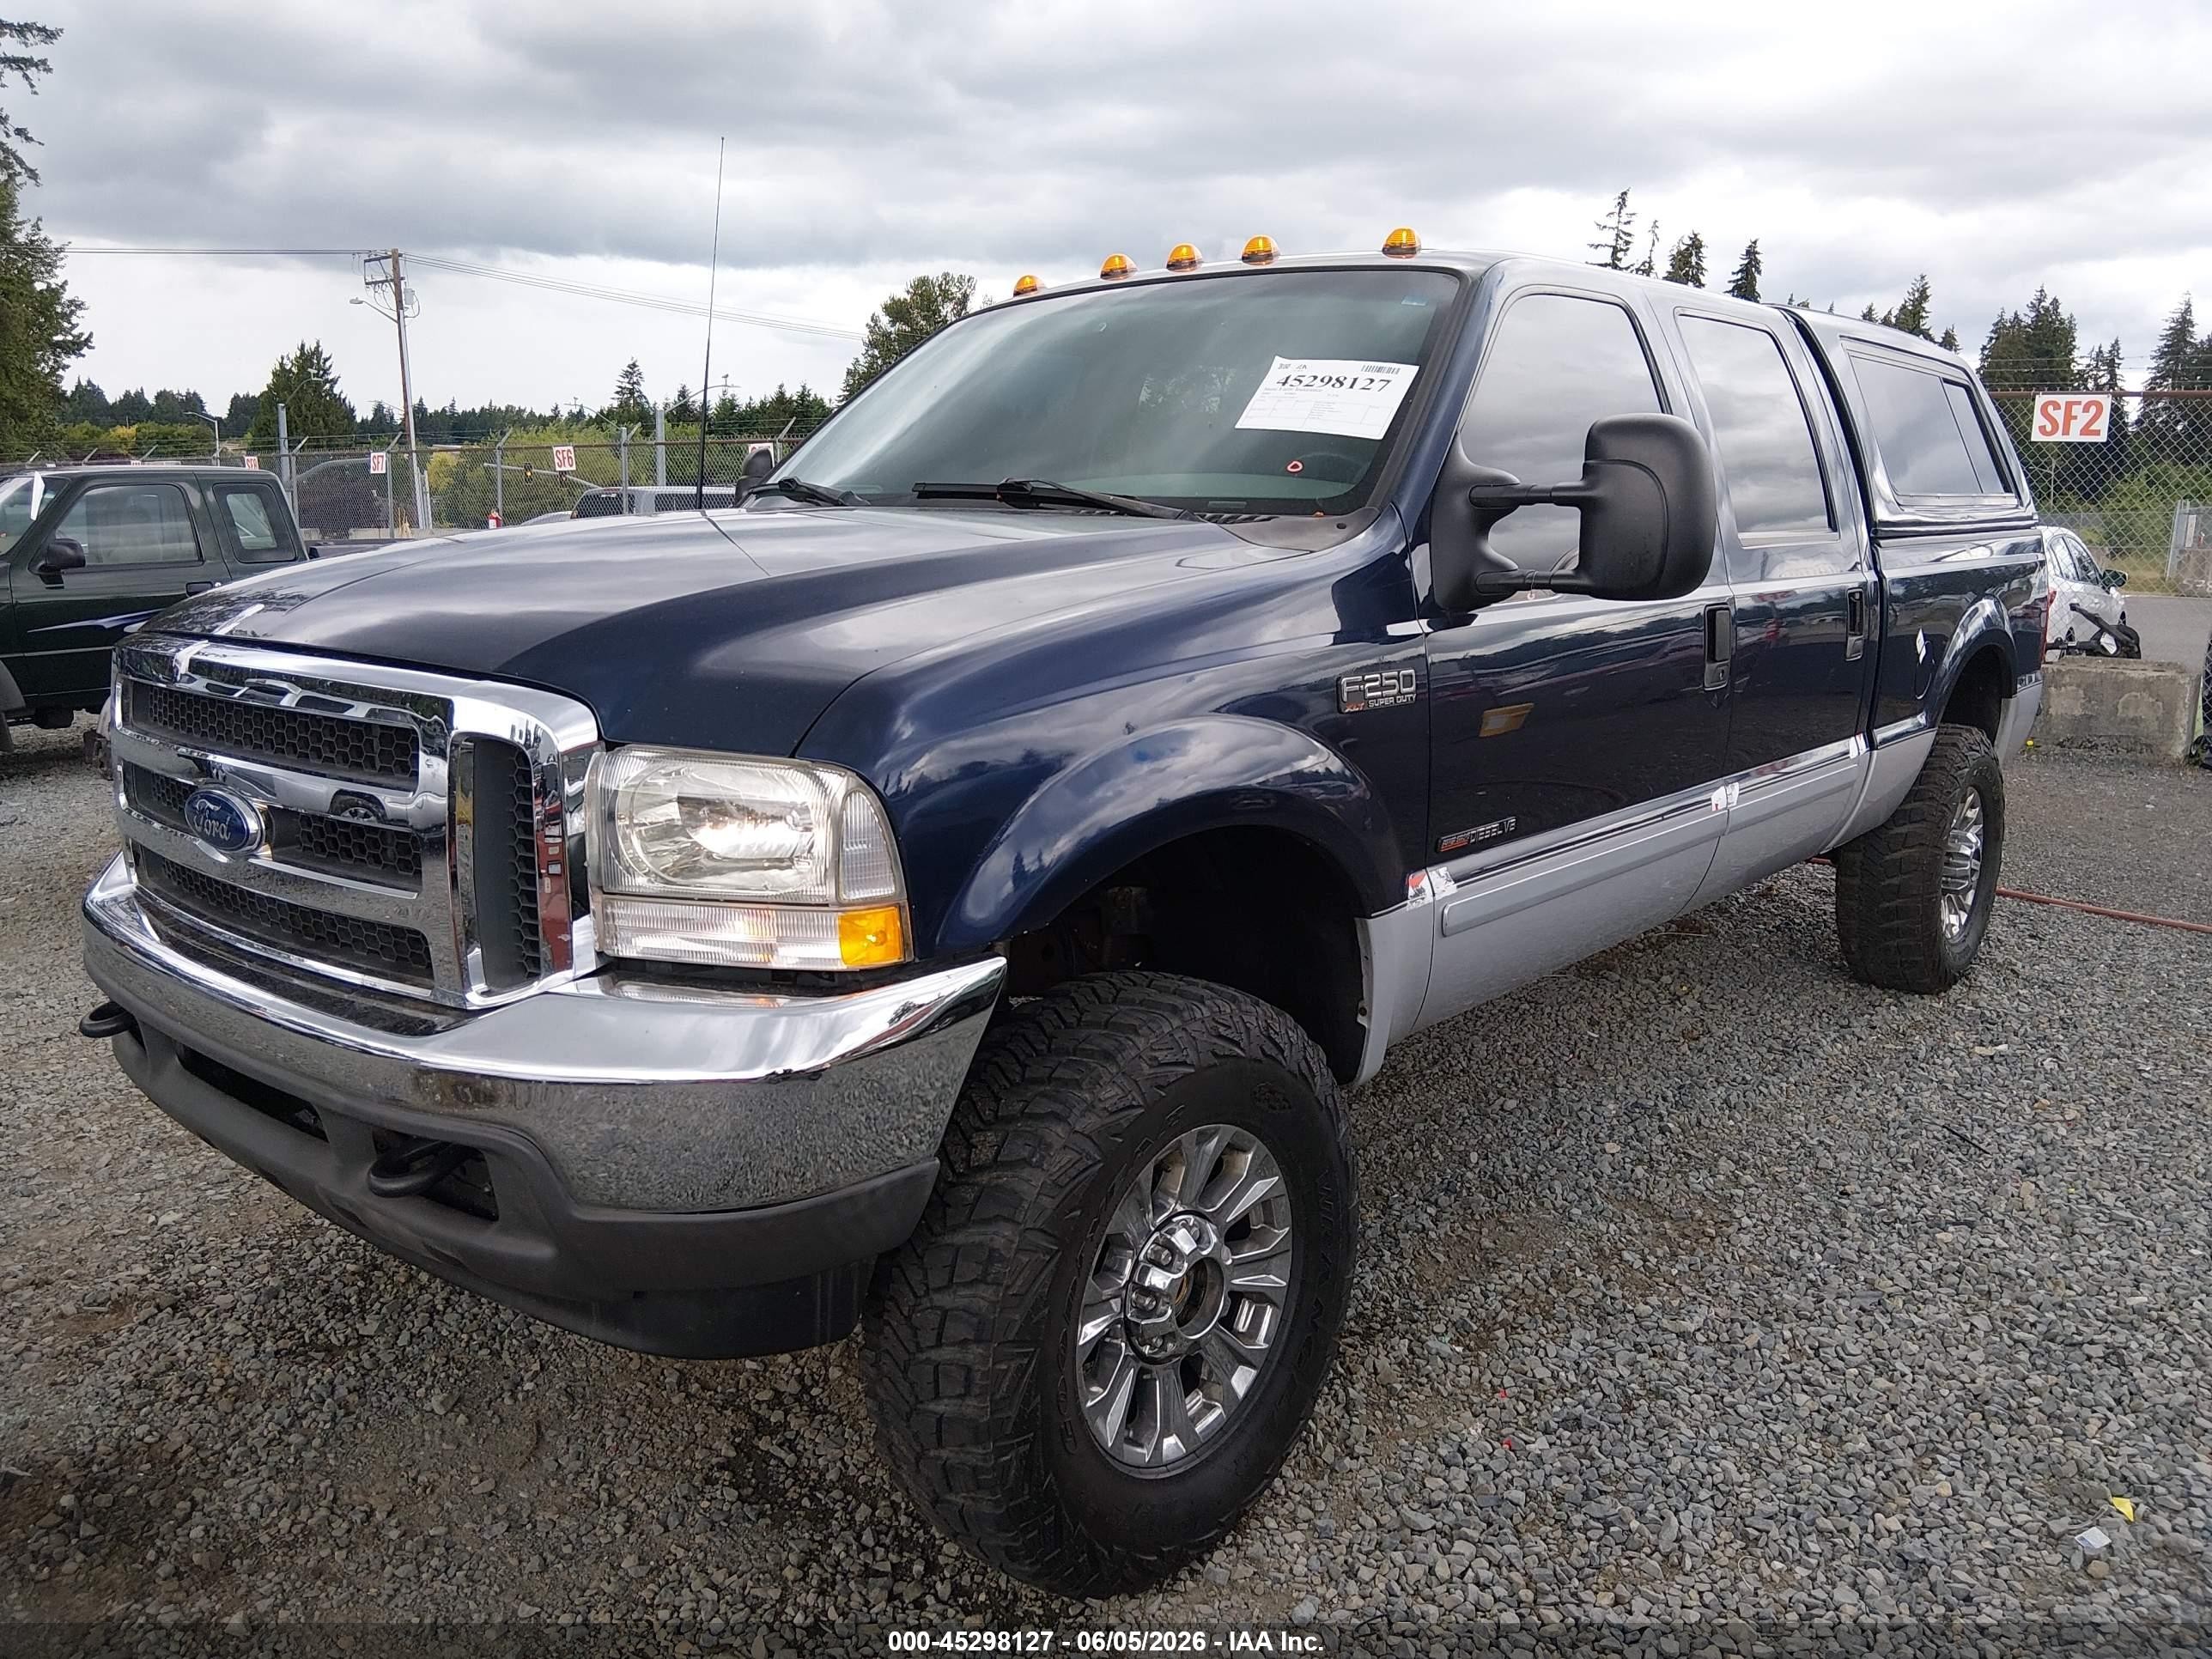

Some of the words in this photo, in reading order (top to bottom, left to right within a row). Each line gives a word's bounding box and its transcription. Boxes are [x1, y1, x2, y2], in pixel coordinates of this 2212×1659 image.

[1276, 374, 1393, 392] 45298127
[2038, 399, 2104, 436] SF2
[372, 455, 384, 471] SF7
[555, 448, 574, 468] SF6
[1368, 696, 1395, 708] SUPER
[1395, 693, 1417, 703] DUTY
[193, 798, 232, 842] Ford
[1469, 823, 1503, 844] DIESEL
